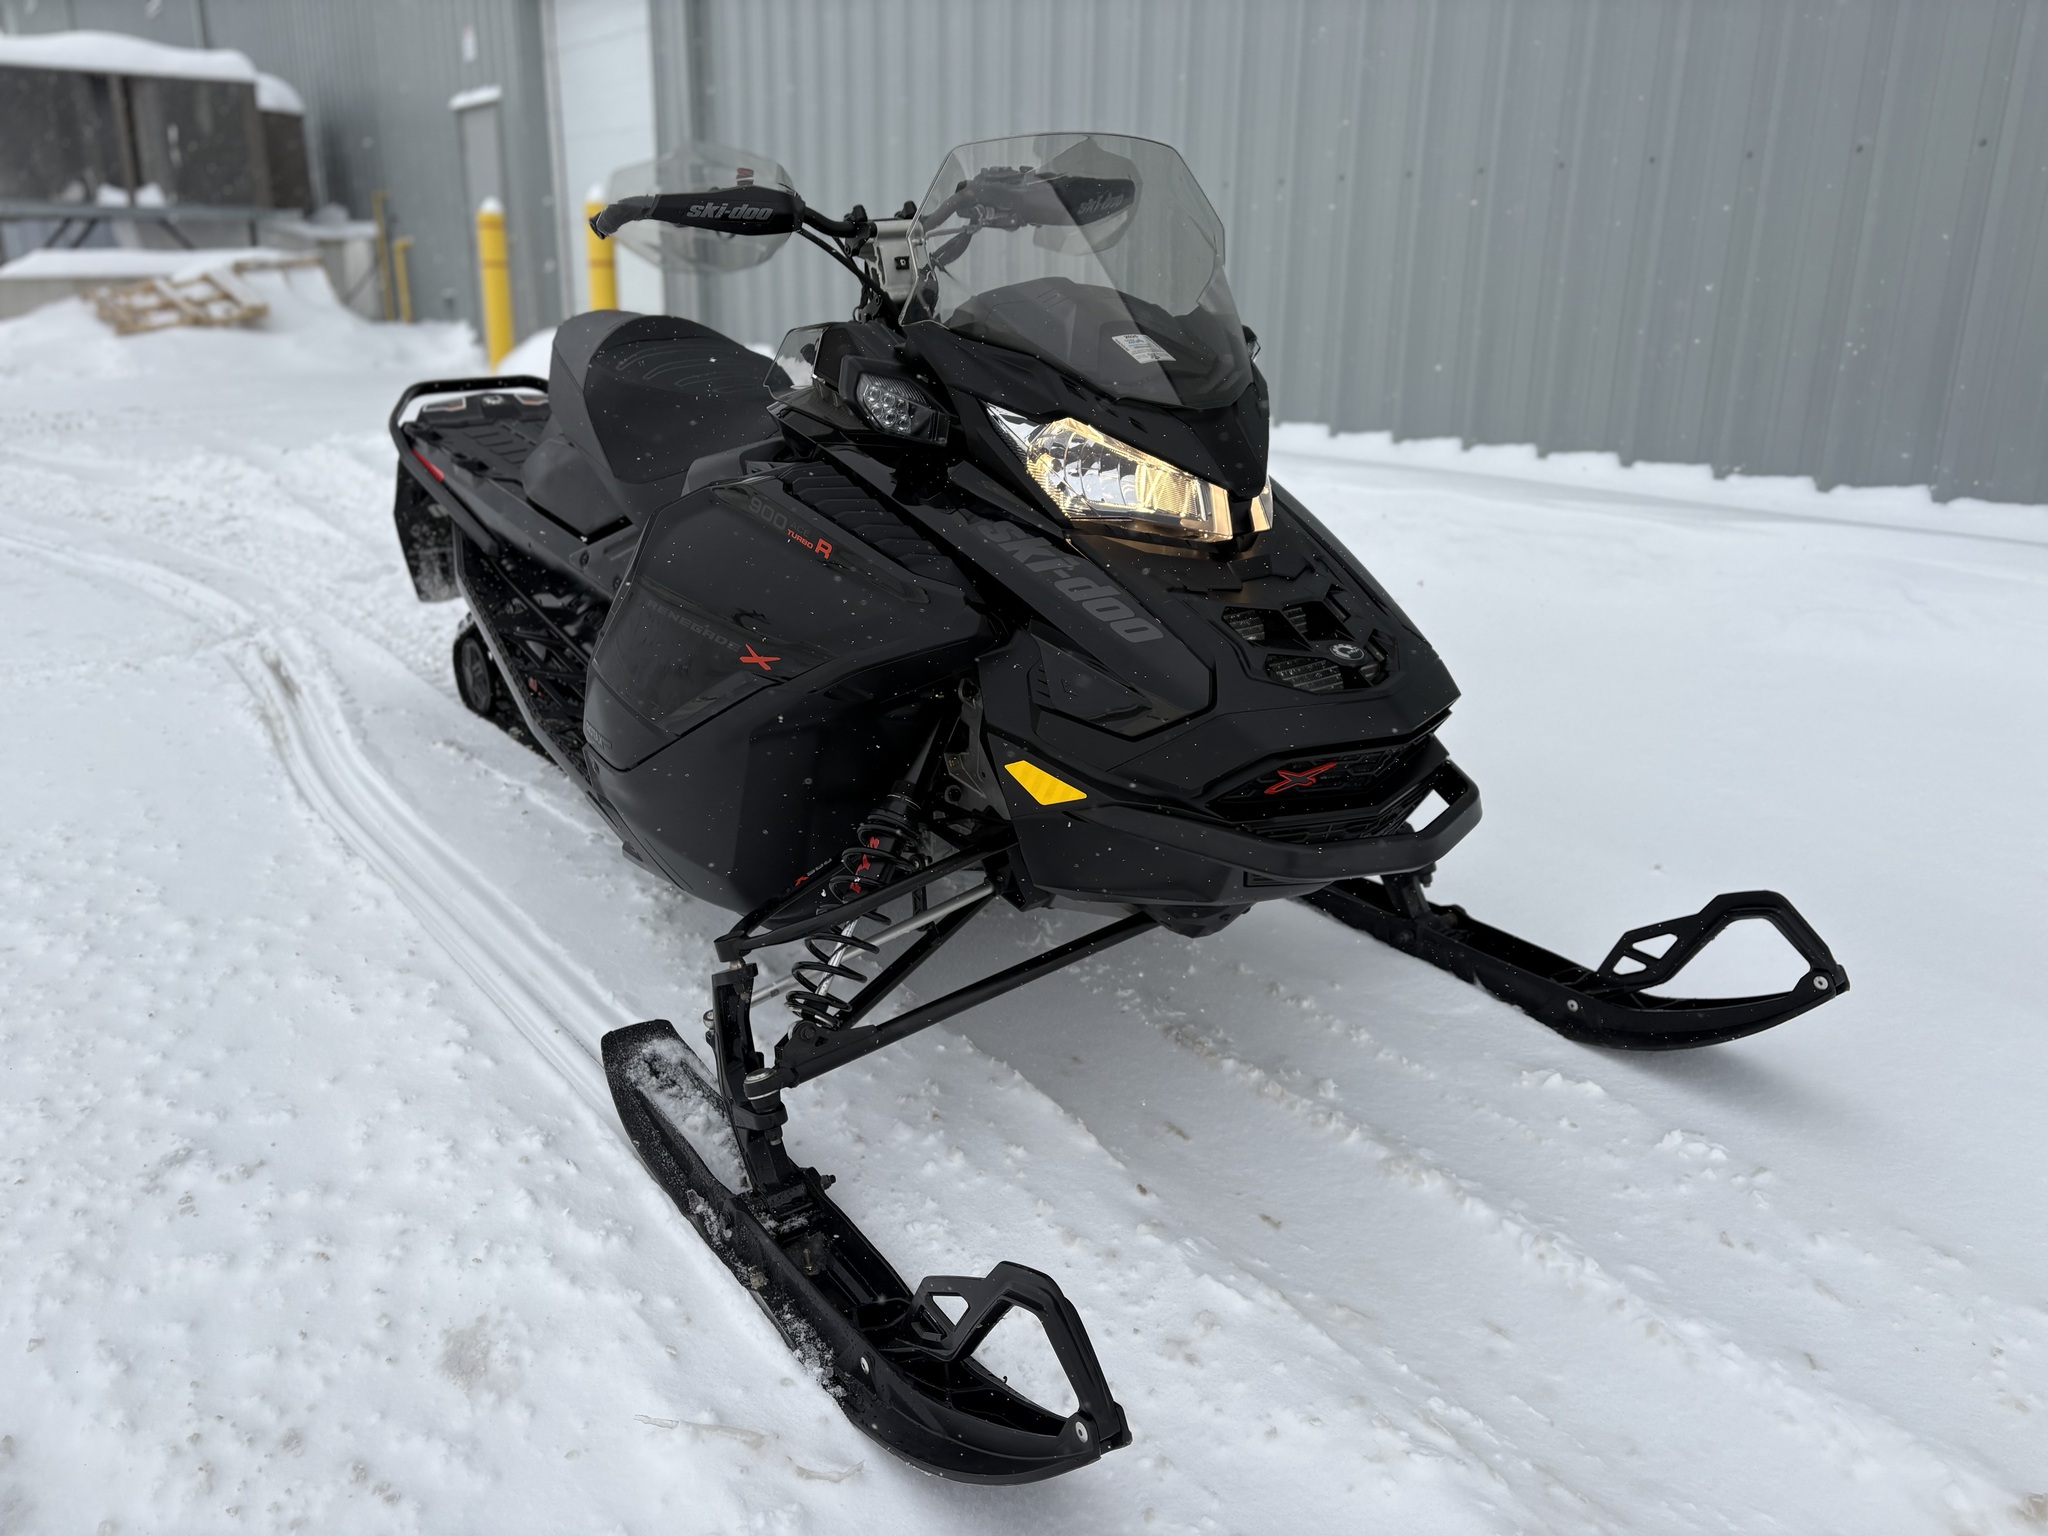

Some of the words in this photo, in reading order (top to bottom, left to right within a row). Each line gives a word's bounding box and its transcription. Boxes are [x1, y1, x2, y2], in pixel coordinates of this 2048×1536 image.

[686, 202, 774, 220] ski-doo
[749, 497, 788, 531] 900
[789, 521, 811, 538] ACE
[787, 529, 814, 550] TURBO
[815, 538, 833, 560] R
[977, 520, 1164, 643] ski-doo
[646, 599, 742, 653] RENEGADE
[739, 643, 781, 671] X
